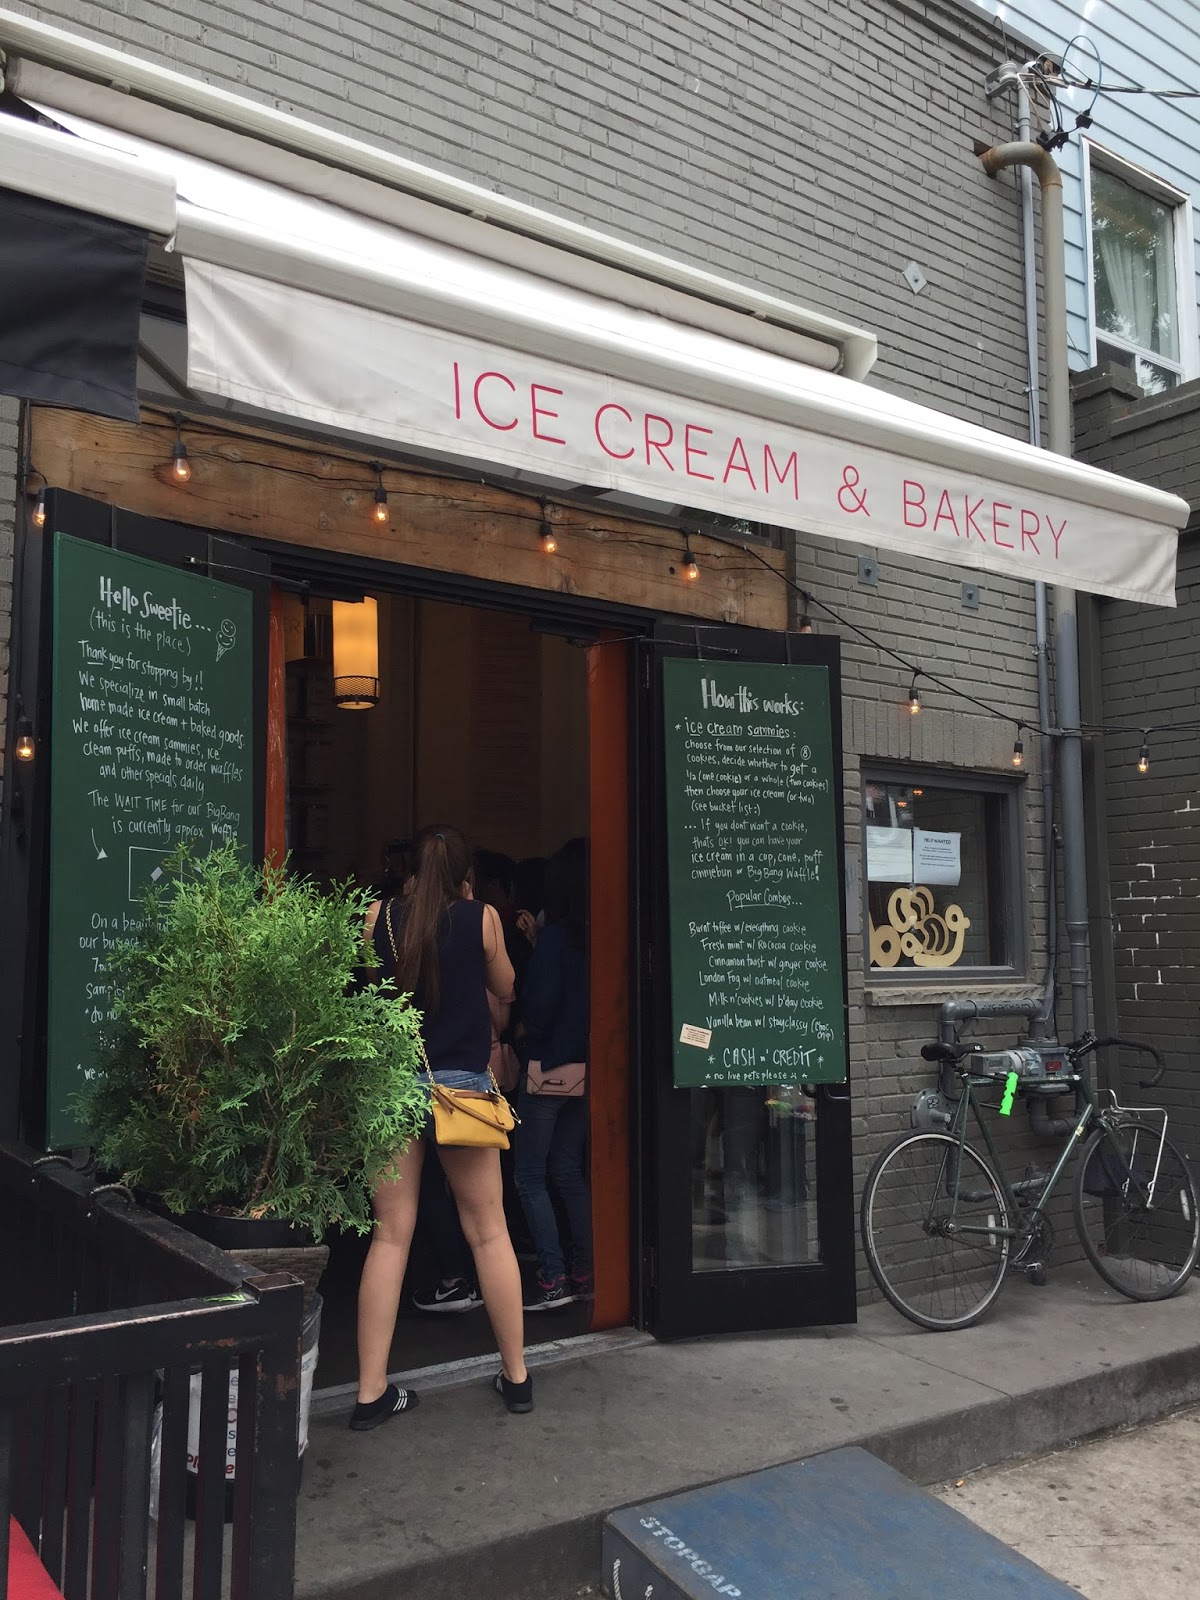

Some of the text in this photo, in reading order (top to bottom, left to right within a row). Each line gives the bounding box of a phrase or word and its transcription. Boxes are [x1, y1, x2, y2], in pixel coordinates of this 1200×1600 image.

[453, 361, 1068, 559] ICE CREAM & BAKERY
[99, 575, 139, 614] Hello
[89, 606, 192, 656] (this is the place)
[78, 639, 108, 660] Thank
[109, 654, 124, 671] you
[126, 651, 140, 671] for
[141, 660, 178, 689] stopping
[78, 670, 210, 716] We specialize in small batch
[701, 678, 805, 716] How this works:
[80, 692, 106, 712] home
[108, 700, 134, 718] made
[138, 704, 151, 721] ice
[153, 711, 178, 727] cream
[180, 719, 188, 731] +
[190, 719, 217, 740] baked
[684, 716, 704, 733] ice
[706, 722, 743, 736] cream
[72, 718, 221, 761] We offer ice cream sammies, ice
[684, 739, 713, 750] choose
[714, 738, 733, 752] from
[735, 744, 747, 752] our
[748, 744, 782, 756] selection
[785, 743, 796, 757] of
[115, 743, 243, 784] puffs, made to order waffles
[686, 752, 817, 778] cookies, decide whether to get a
[99, 762, 205, 802] and other specials daily
[715, 771, 742, 784] cookie)
[753, 774, 759, 782] a
[761, 775, 784, 787] whole
[785, 776, 802, 788] (two
[802, 778, 829, 794] cookies)
[87, 789, 201, 817] The WAIT TIME for our
[684, 784, 815, 806] then choose your ice cream (or two)
[691, 799, 737, 812] (see bucket
[111, 815, 123, 834] is
[129, 816, 171, 845] currently
[175, 822, 204, 842] approx
[700, 817, 711, 832] If
[714, 821, 728, 837] you
[749, 819, 771, 832] want
[771, 823, 778, 831] a
[780, 820, 808, 834] cookie,
[691, 836, 715, 850] thats
[736, 837, 750, 852] you
[751, 836, 765, 847] can
[767, 834, 785, 846] have
[785, 837, 803, 850] your
[691, 848, 824, 869] ice cream in a cup, puff
[785, 864, 820, 882] Waffle!
[725, 889, 763, 912] Popular
[91, 912, 118, 930] On a
[688, 920, 807, 938] Burnt toffee cookie
[79, 936, 99, 949] our
[699, 936, 817, 954] Fresh mint w/ cookie
[708, 953, 828, 977] Cinnamon toast w/ ginger cookie
[698, 969, 810, 993] London Fog w/ oatmeal cookie
[708, 991, 824, 1013] Milk w/ b'day cookie
[705, 1013, 766, 1029] Vanilla bean w/
[723, 1047, 756, 1068] CASH
[772, 1045, 817, 1068] CREDIT
[727, 1070, 741, 1081] live
[743, 1070, 760, 1080] pets
[761, 1069, 788, 1082] please
[639, 1516, 742, 1597] STOPGAP
